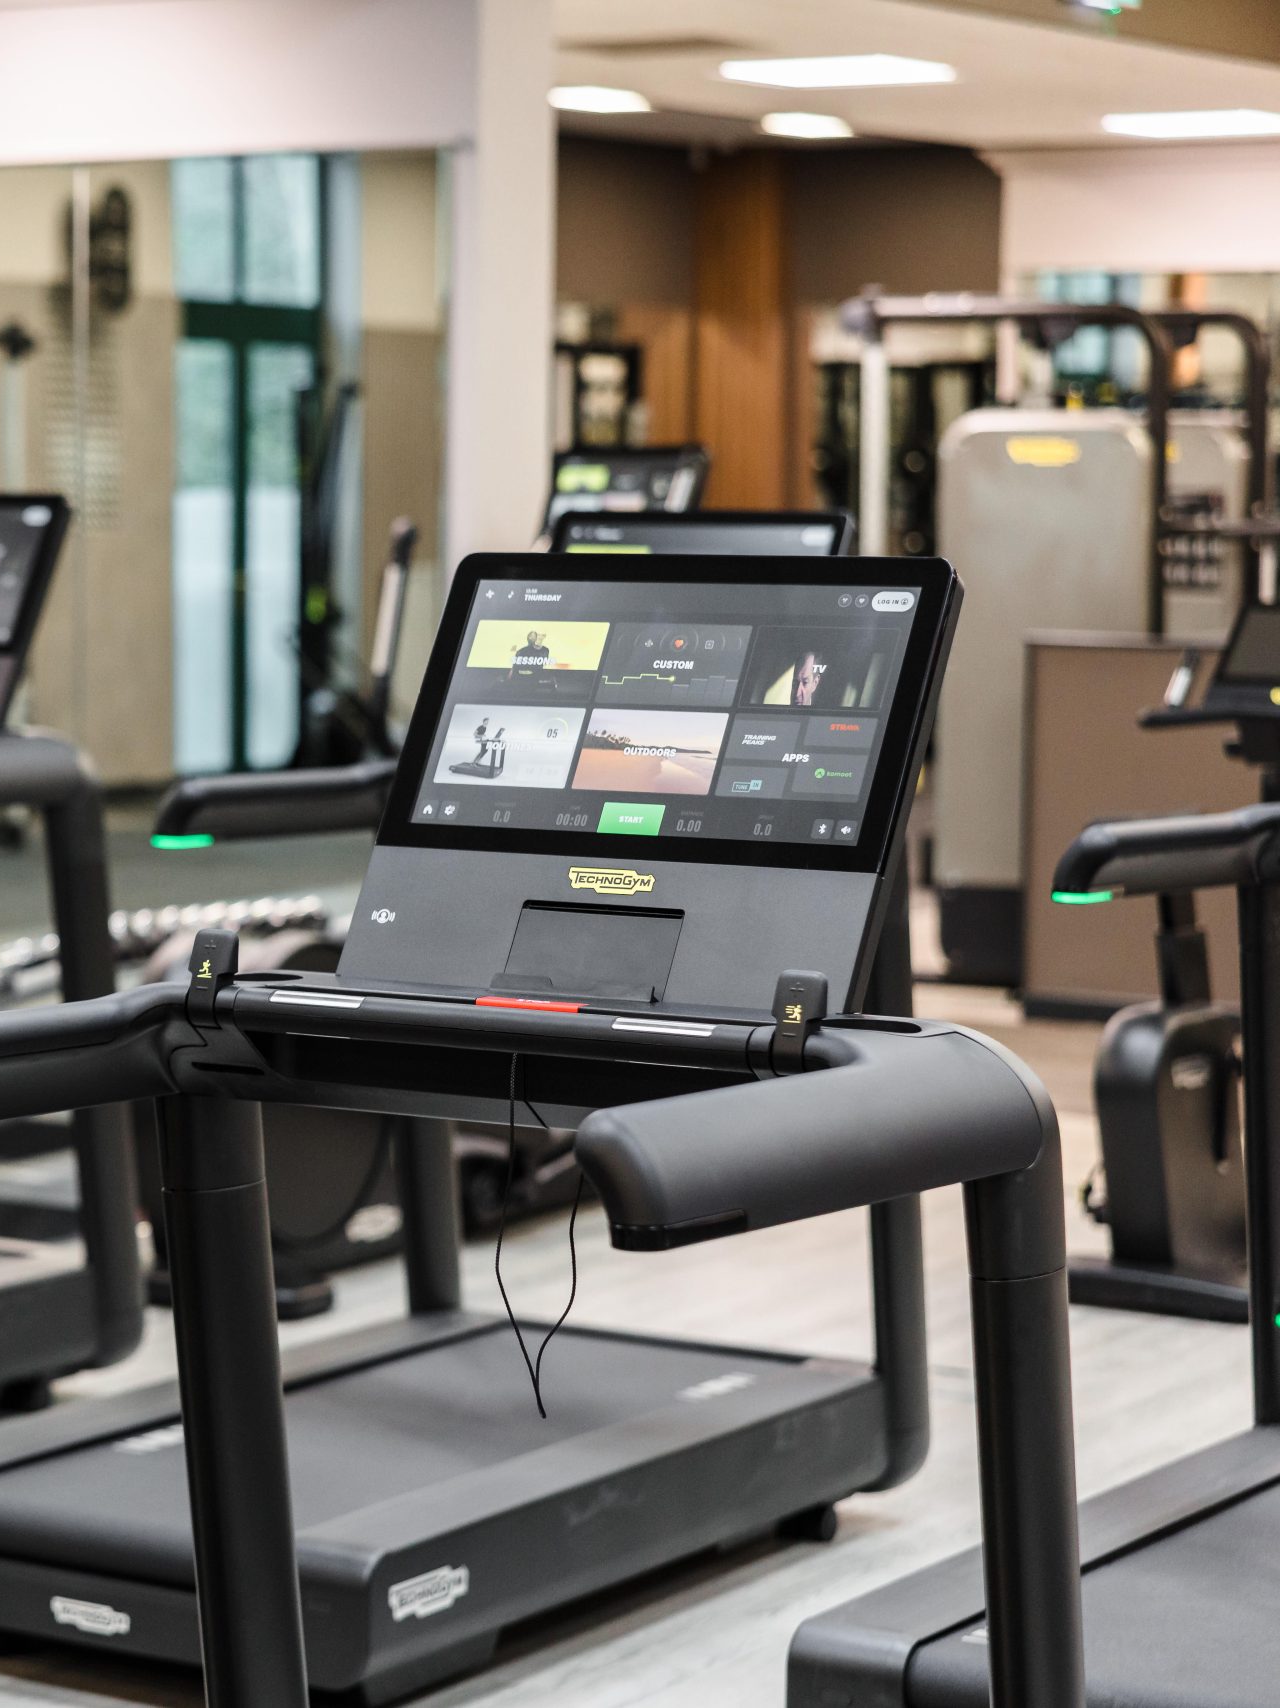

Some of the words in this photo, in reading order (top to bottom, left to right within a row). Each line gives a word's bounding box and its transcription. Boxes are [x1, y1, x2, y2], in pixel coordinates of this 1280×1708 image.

[524, 594, 561, 602] THURSDAY
[511, 656, 557, 666] SESSIONS
[653, 660, 694, 670] CUSTOM
[812, 664, 827, 674] TV
[546, 728, 559, 739] 05
[623, 746, 677, 757] OUTDOORS
[781, 753, 810, 763] APPS
[492, 810, 511, 823] 0.0
[555, 813, 588, 827] 00:00
[618, 815, 644, 824] START
[676, 819, 702, 833] 0.00
[753, 823, 773, 836] 0.0
